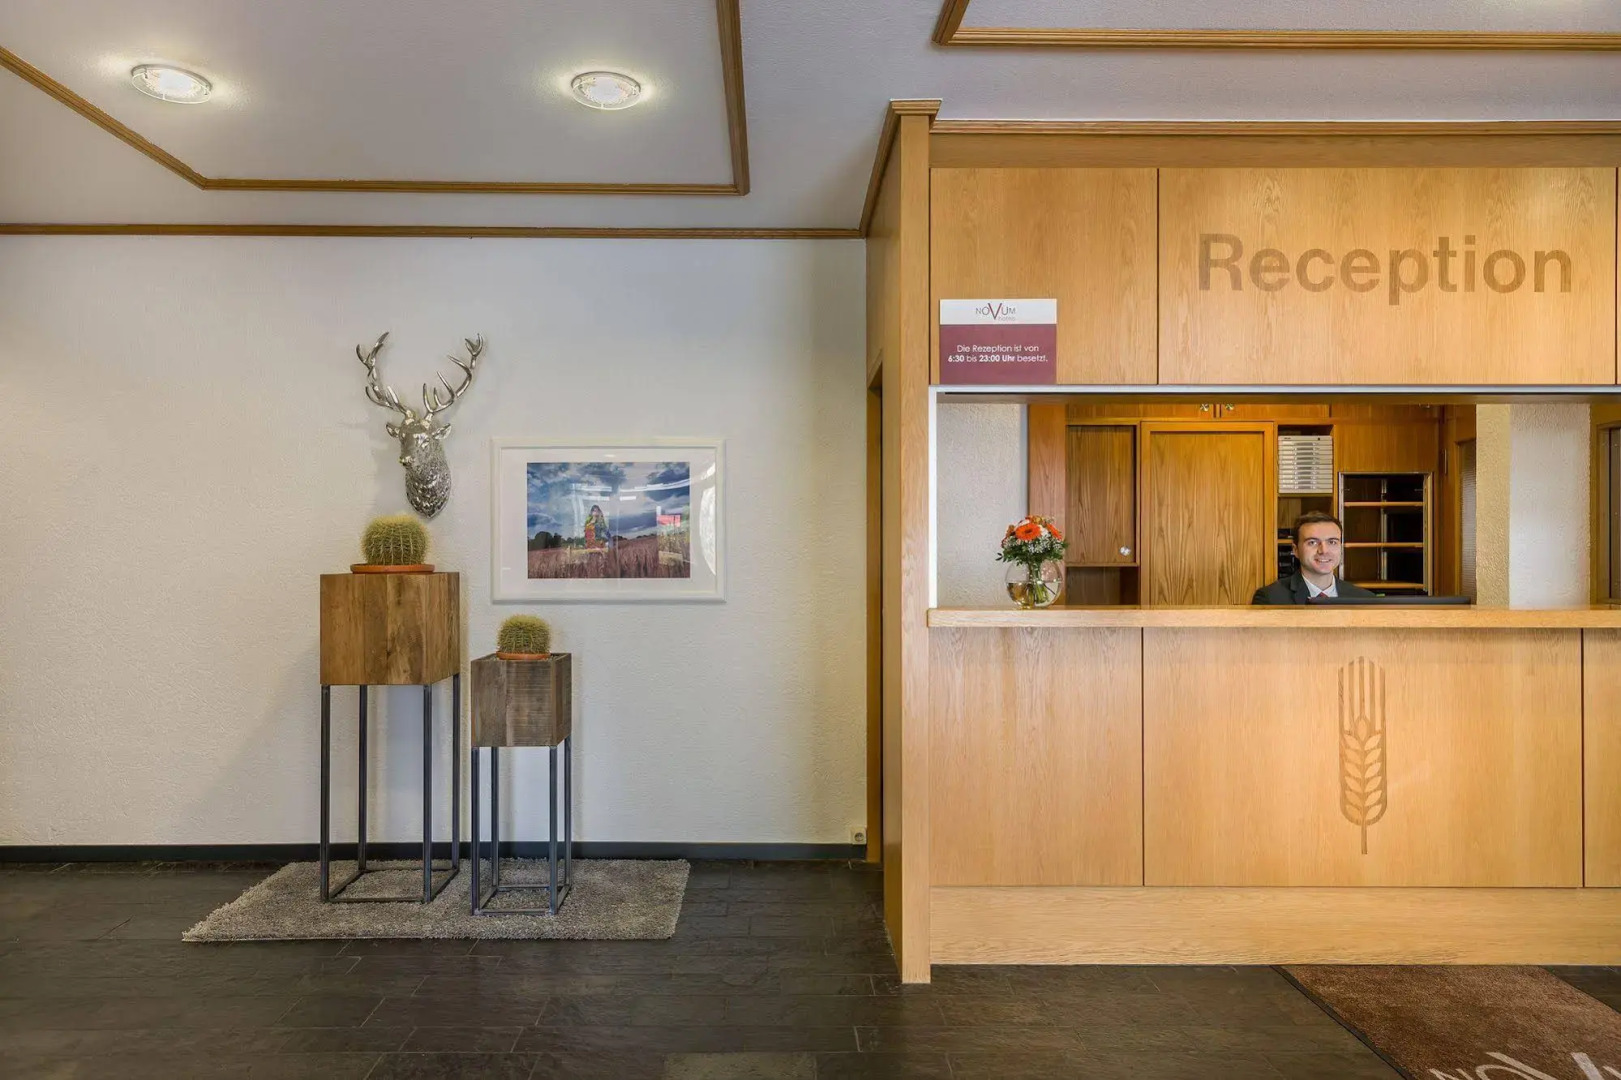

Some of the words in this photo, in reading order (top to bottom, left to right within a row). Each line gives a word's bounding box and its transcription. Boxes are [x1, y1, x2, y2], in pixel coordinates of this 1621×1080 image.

[1198, 233, 1573, 306] Reception
[975, 302, 1016, 320] NOVUM
[956, 344, 971, 353] Die
[972, 344, 1013, 355] Rezeption
[1013, 344, 1022, 353] ist
[1023, 345, 1040, 353] von
[947, 354, 965, 363] 6:30
[966, 354, 978, 363] bis
[979, 354, 1001, 363] 23:00
[1001, 354, 1015, 363] Uhr
[1016, 354, 1049, 363] besetzt.
